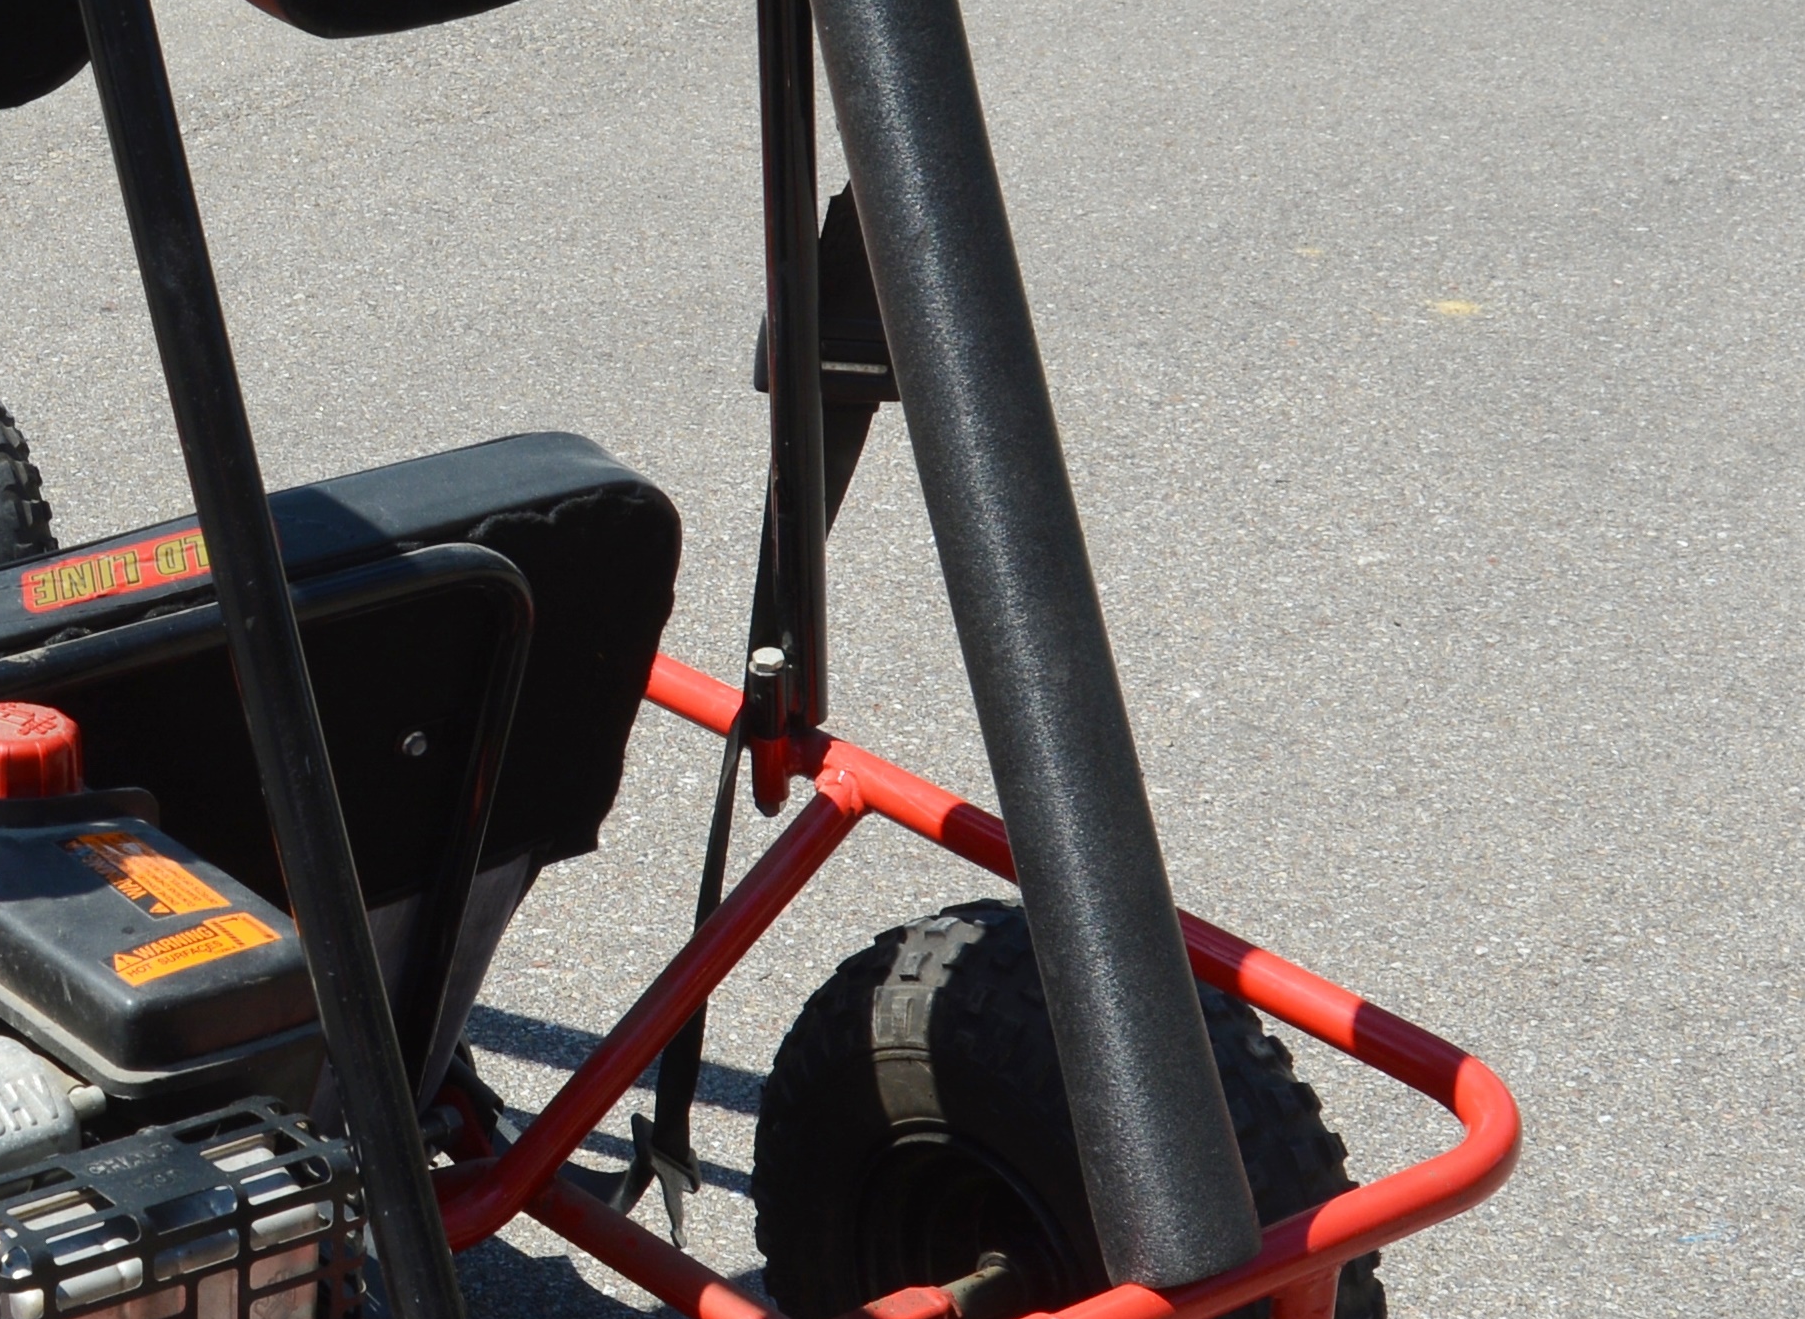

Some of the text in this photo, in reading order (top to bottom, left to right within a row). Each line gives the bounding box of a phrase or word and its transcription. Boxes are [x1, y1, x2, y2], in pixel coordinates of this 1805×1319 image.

[31, 550, 142, 607] LINE
[126, 962, 155, 977] HOT
[157, 940, 224, 966] SURFACES
[132, 925, 215, 959] WARNING
